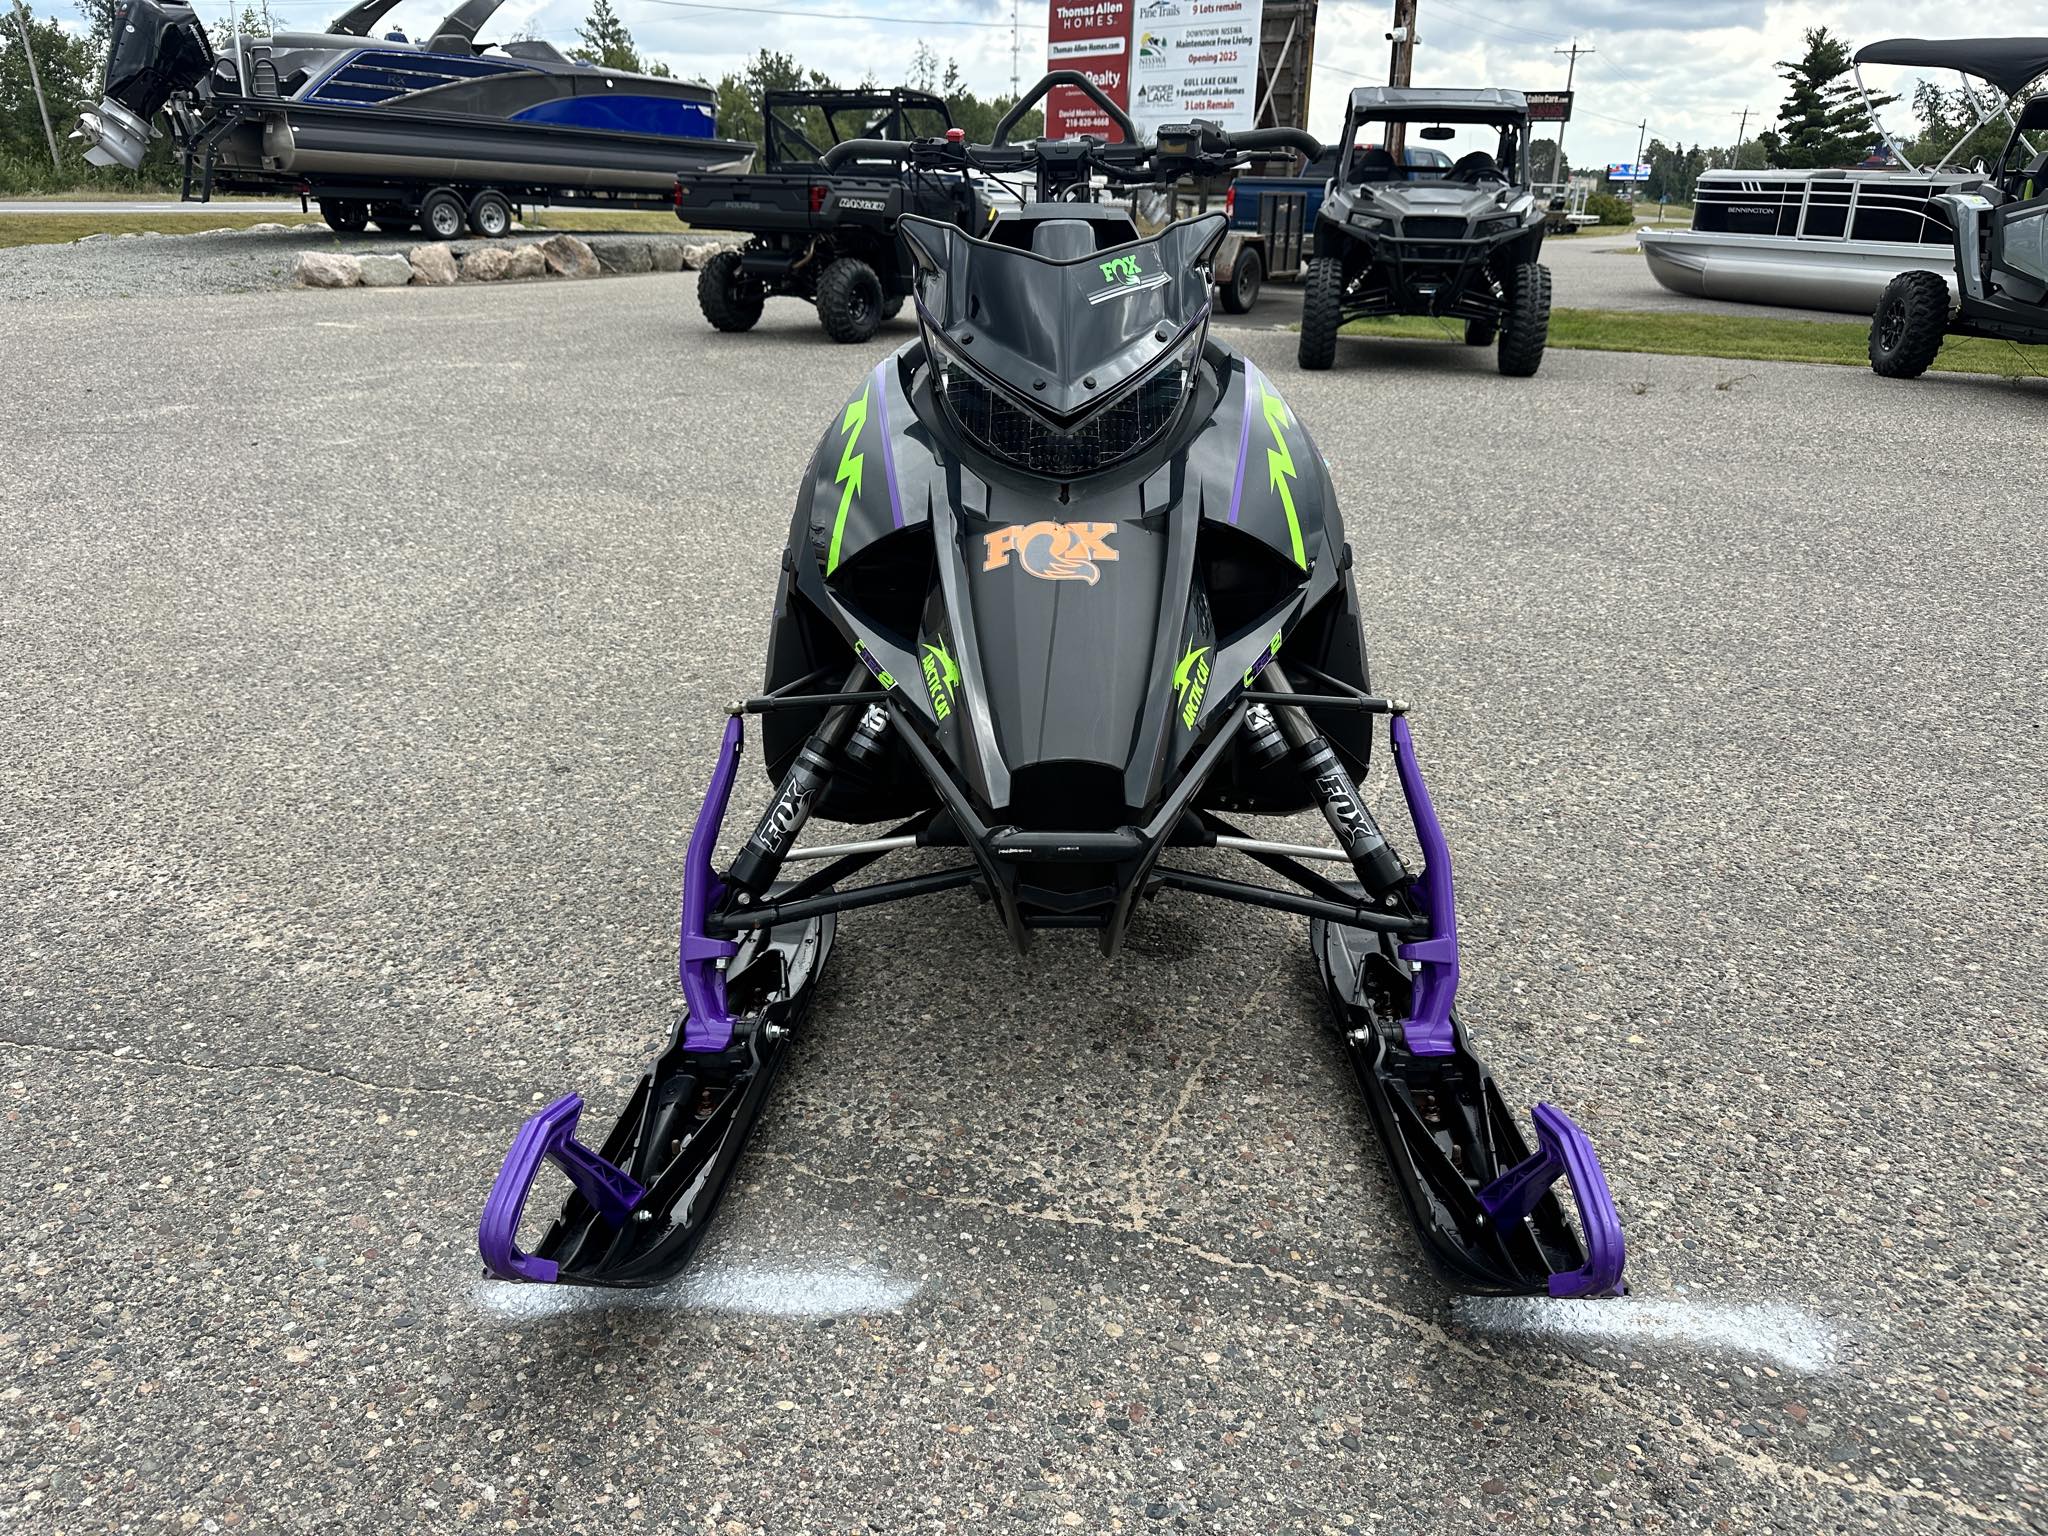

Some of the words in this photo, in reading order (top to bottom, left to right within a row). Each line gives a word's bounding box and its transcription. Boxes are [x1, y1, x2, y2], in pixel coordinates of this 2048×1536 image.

[1056, 7, 1095, 19] Thomas
[1096, 2, 1124, 14] Allen
[1139, 6, 1157, 19] Pine
[1159, 4, 1181, 17] Trails
[1192, 5, 1198, 15] 9
[1200, 4, 1214, 14] Lots
[1215, 1, 1242, 12] remain
[1063, 15, 1114, 29] HOMES
[1186, 28, 1219, 38] DOWNTOWN
[1220, 26, 1243, 35] NISSWA
[1175, 38, 1216, 48] Maintenance
[1217, 37, 1231, 46] Free
[1232, 35, 1253, 46] Living
[1053, 46, 1073, 54] Thomas
[1074, 44, 1088, 52] Allen
[1188, 53, 1218, 65] Opening
[1219, 51, 1238, 61] 2025
[1085, 70, 1120, 89] Realty
[1183, 78, 1199, 87] GULL
[1200, 77, 1216, 86] LAKE
[1217, 76, 1238, 85] CHAIN
[1146, 92, 1174, 103] LAKE
[1181, 88, 1208, 97] Beautiful
[1209, 87, 1223, 95] Lake
[1223, 87, 1245, 95] Homes
[1184, 100, 1190, 110] 3
[1190, 100, 1205, 110] Lots
[1206, 98, 1235, 110] Remain
[838, 197, 886, 211] RANGER
[1727, 206, 1775, 215] BENNINGTON
[1099, 254, 1142, 286] FOX
[983, 520, 1120, 587] FOX
[922, 652, 942, 699] ARCTIC
[934, 693, 951, 721] CAT
[1182, 677, 1204, 731] ARCTIC
[1196, 655, 1210, 685] CAT
[758, 776, 817, 854] FOX
[1315, 774, 1375, 848] FOX
